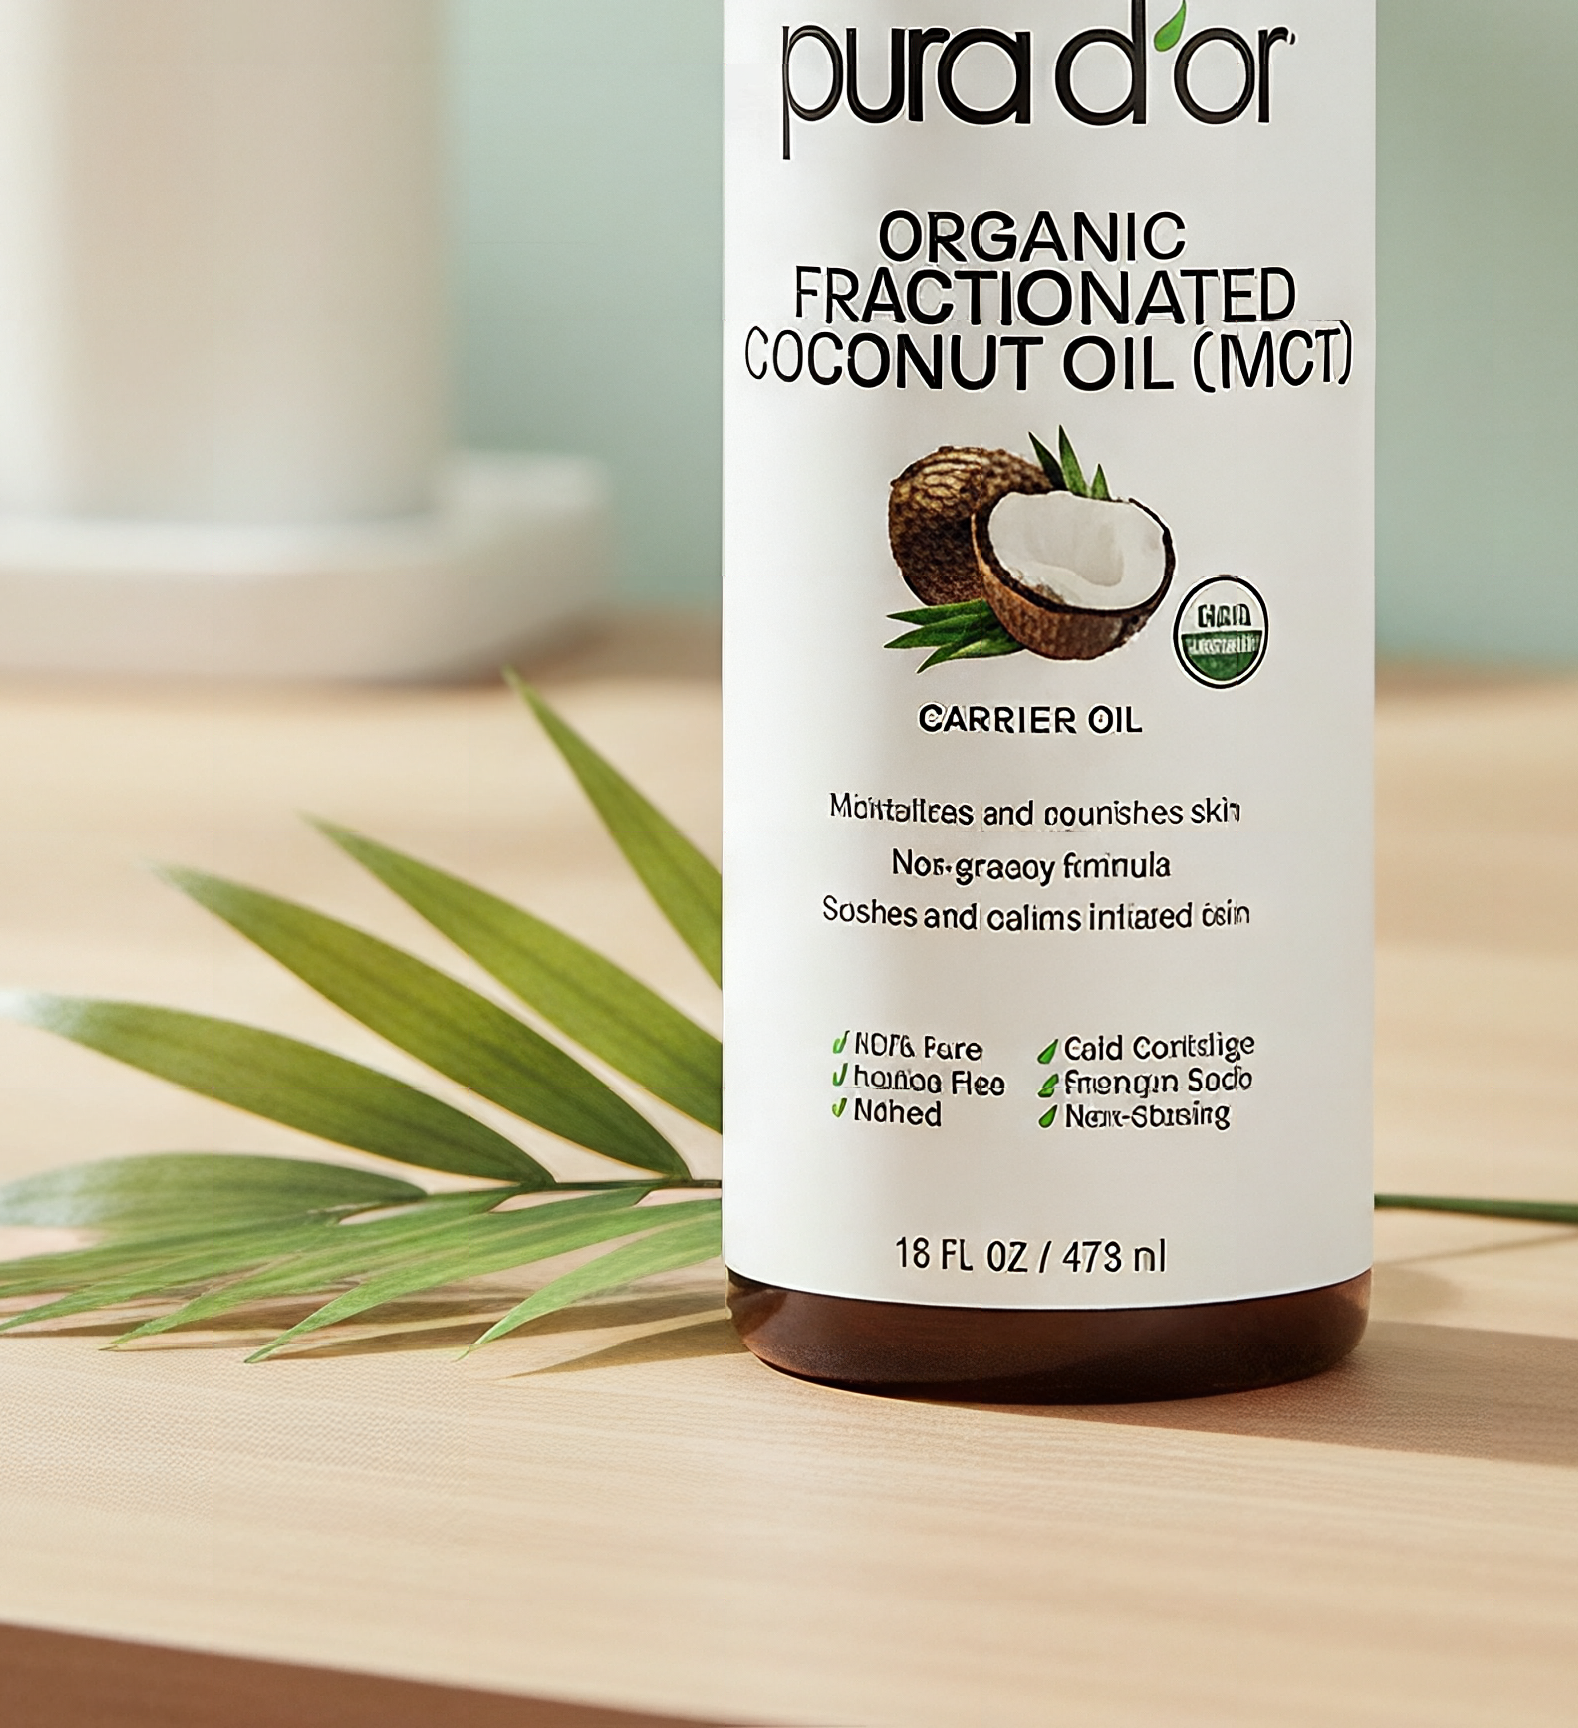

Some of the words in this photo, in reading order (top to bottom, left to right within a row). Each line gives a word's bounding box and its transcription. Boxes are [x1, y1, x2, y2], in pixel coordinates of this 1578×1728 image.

[782, 25, 1031, 160] pura
[879, 210, 1186, 262] ORGANIC
[795, 266, 1296, 325] FRACTIONATED
[744, 326, 1044, 390] COCONUT
[1063, 335, 1174, 391] OIL
[1193, 321, 1352, 393] (MCT)
[919, 704, 1077, 734] CARRIER
[1088, 705, 1143, 734] OIL
[984, 800, 1034, 826] and
[924, 903, 977, 929] and
[896, 1236, 930, 1269] 18
[942, 1238, 974, 1271] FL
[1038, 1240, 1052, 1274] /
